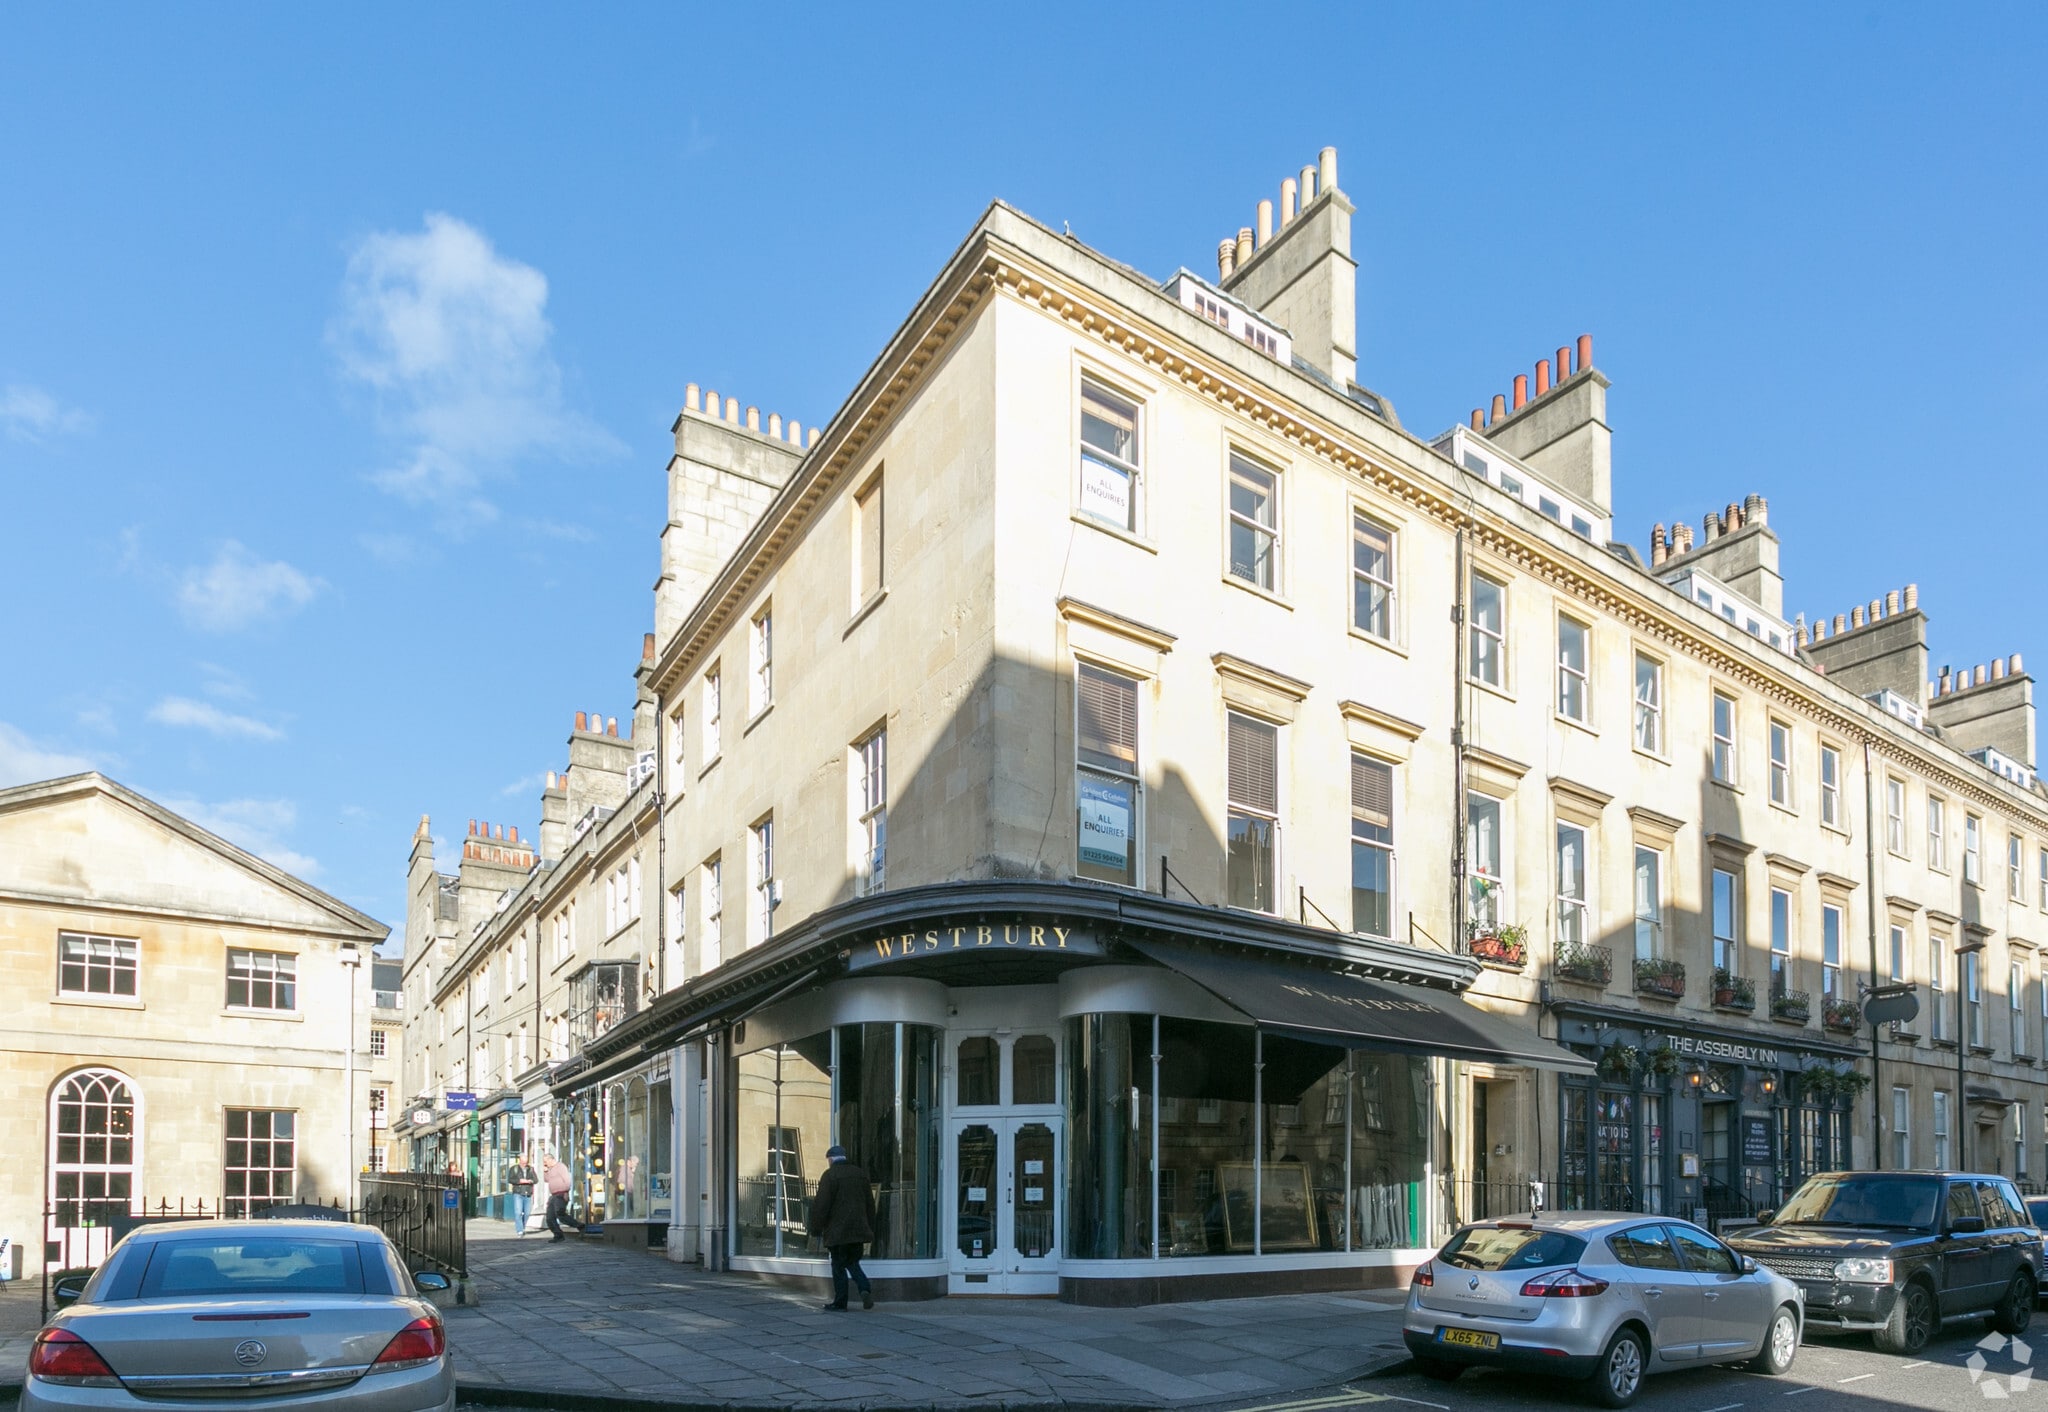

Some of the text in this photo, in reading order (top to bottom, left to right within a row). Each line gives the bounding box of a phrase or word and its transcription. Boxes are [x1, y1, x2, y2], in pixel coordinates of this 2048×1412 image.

[1099, 479, 1113, 491] ALL
[1086, 483, 1126, 507] ENQUIRIES
[1097, 814, 1112, 825] ALL
[1084, 821, 1125, 838] ENQUIRIES
[874, 924, 1071, 960] WESTBURY
[1666, 1034, 1778, 1064] THE ASSEMBLY INN
[1445, 1330, 1495, 1348] LX65 ZNL
